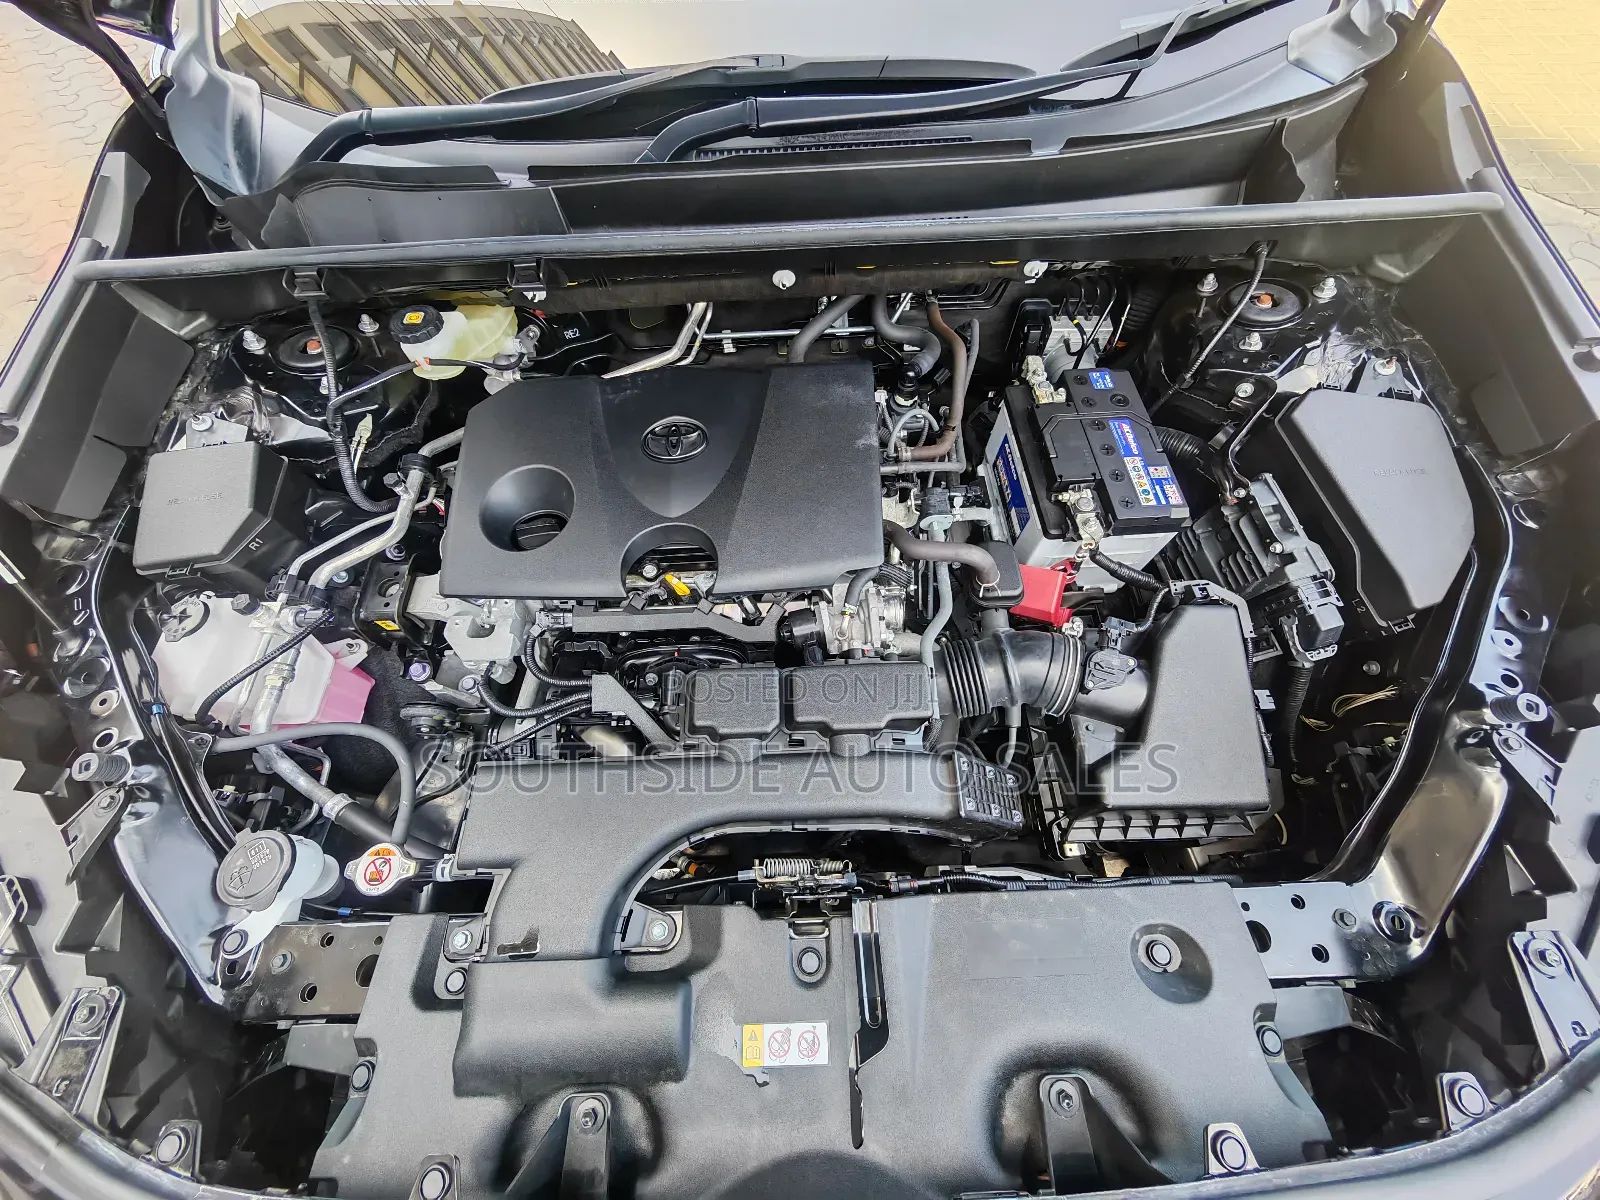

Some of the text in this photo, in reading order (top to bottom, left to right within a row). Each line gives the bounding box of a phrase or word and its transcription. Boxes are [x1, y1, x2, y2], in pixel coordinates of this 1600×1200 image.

[564, 328, 580, 340] RE2
[248, 537, 264, 551] R1
[1351, 598, 1366, 614] L2
